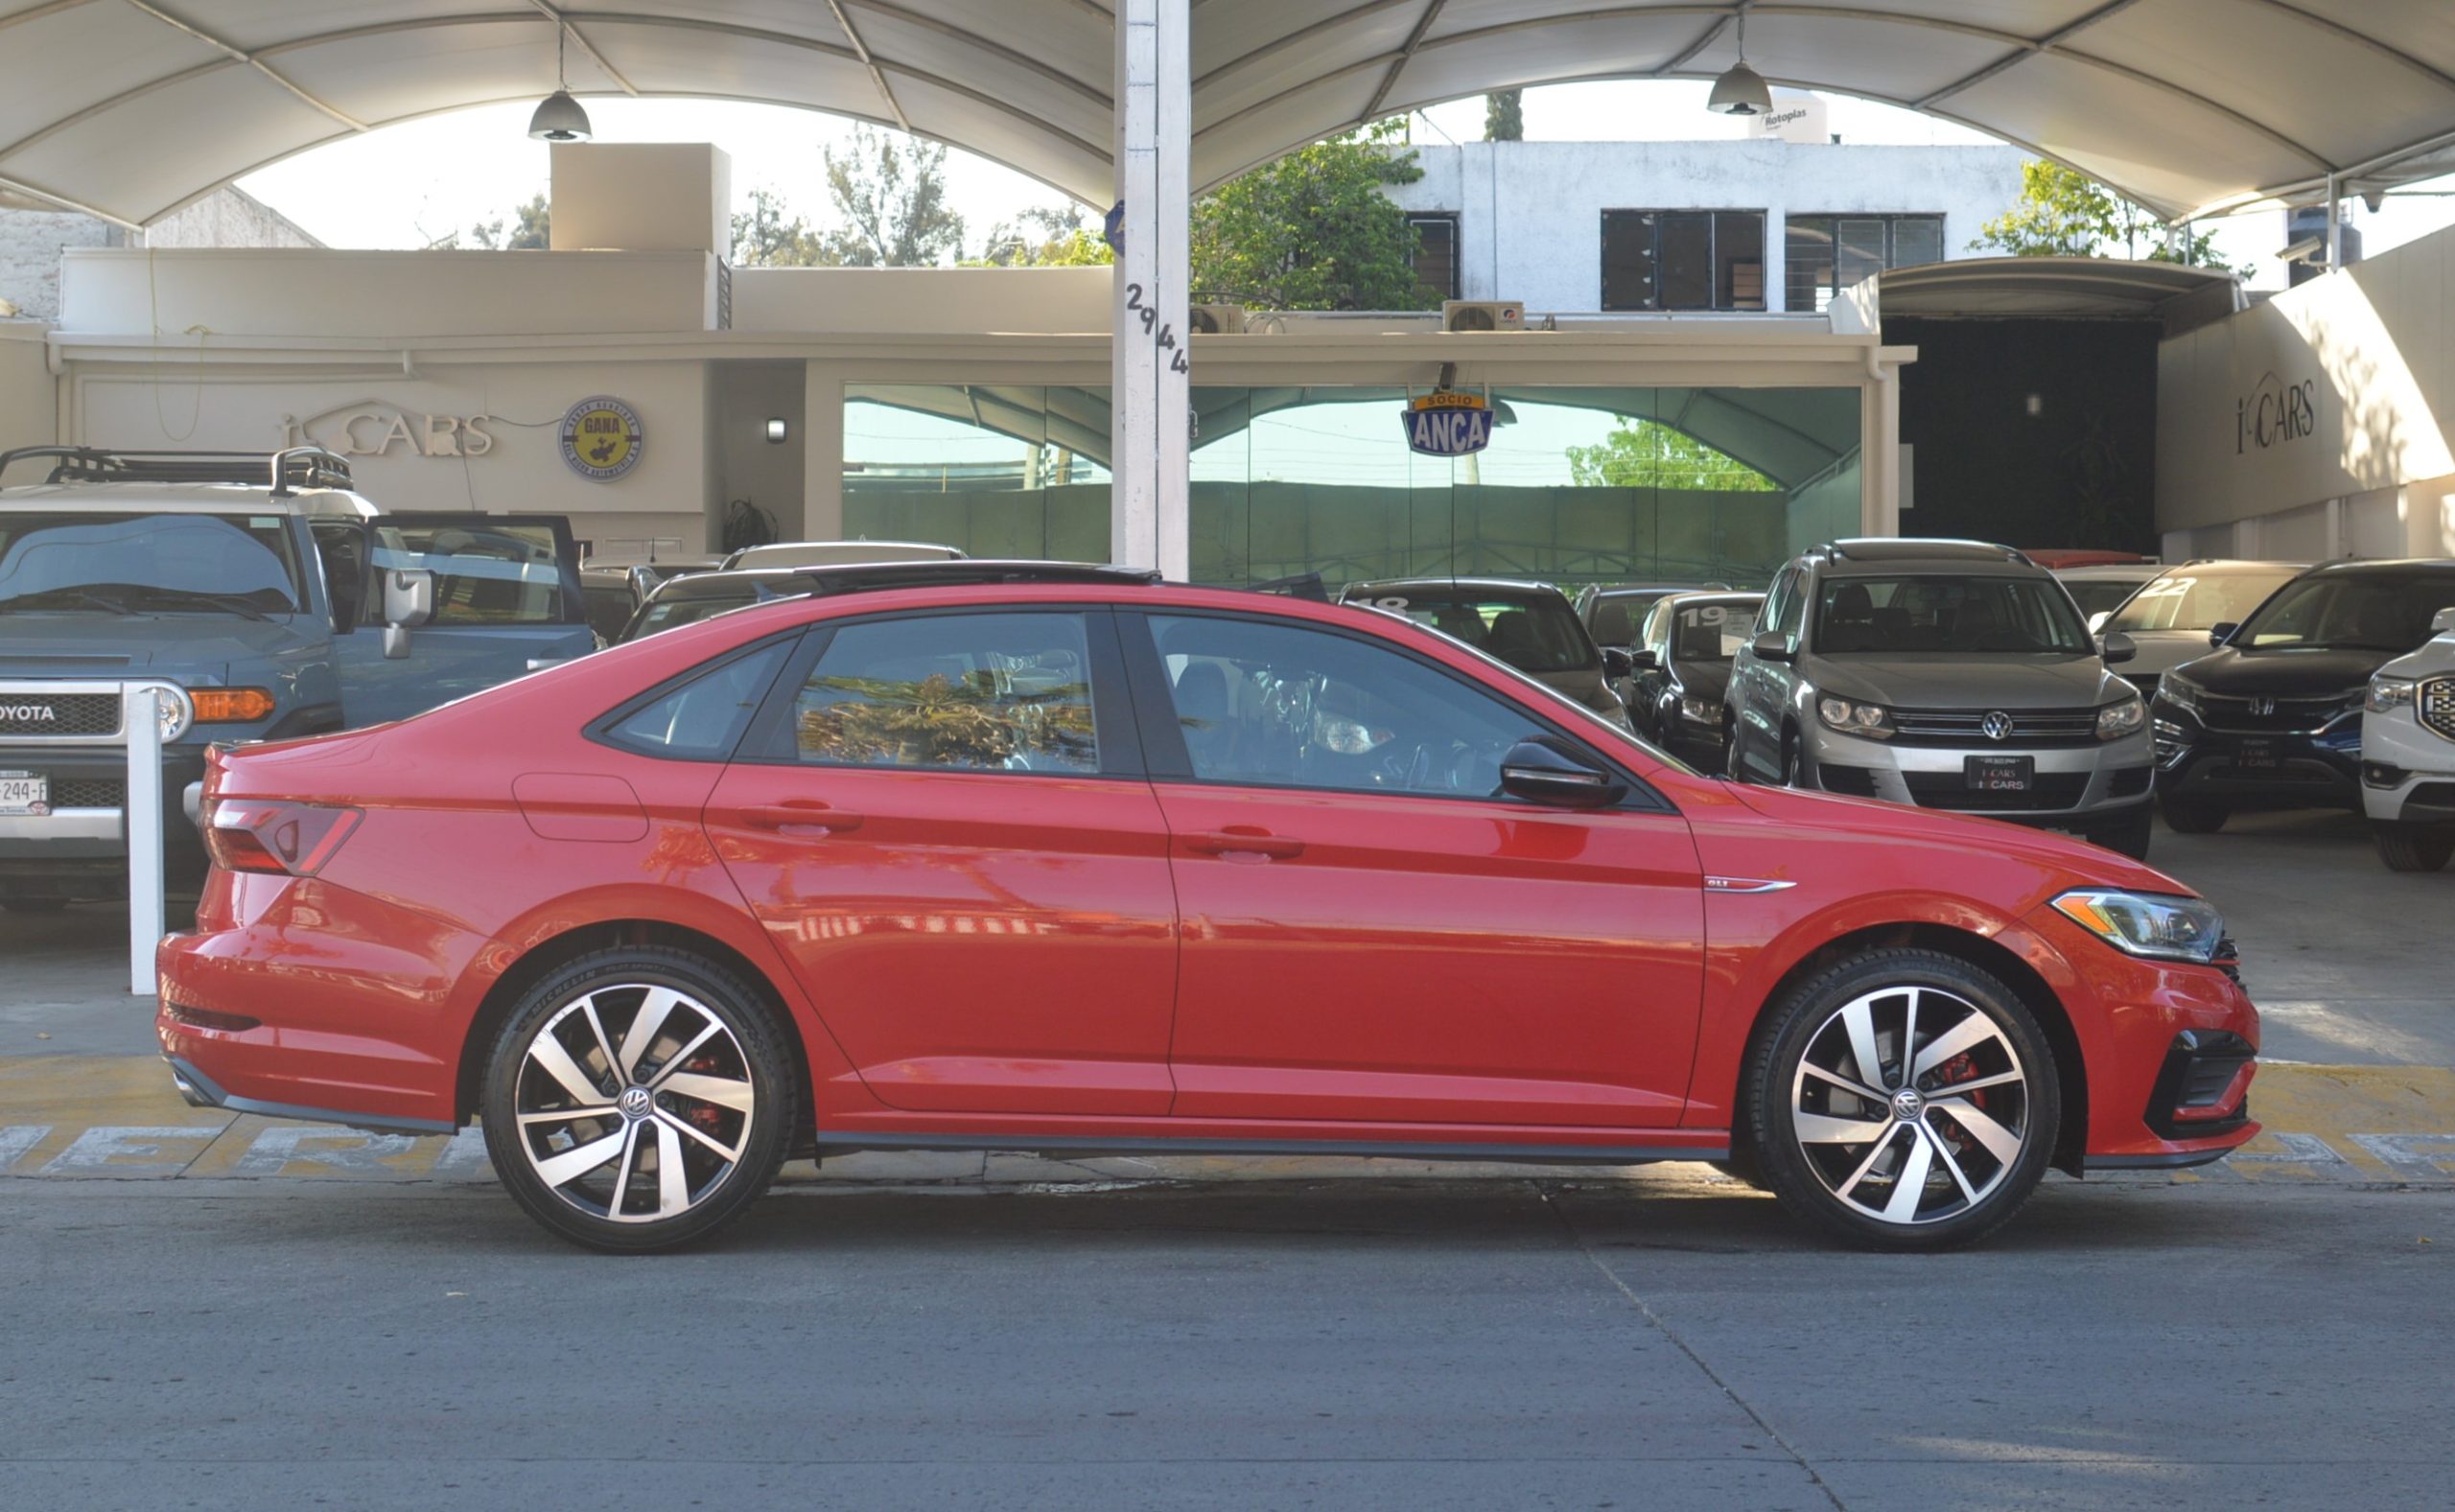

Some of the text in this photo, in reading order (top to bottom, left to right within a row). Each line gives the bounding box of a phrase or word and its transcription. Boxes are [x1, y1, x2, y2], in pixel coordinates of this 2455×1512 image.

[1765, 108, 1807, 127] Rotoplas
[1126, 283, 1189, 375] 2944
[1427, 395, 1473, 406] SOCIO
[2256, 378, 2315, 449] CARS
[344, 413, 494, 456] CARS
[584, 417, 620, 434] GANA
[1414, 411, 1486, 453] ANCA
[2138, 577, 2198, 599] 22
[1679, 606, 1728, 628] 19
[1991, 780, 2025, 790] CARS
[531, 969, 596, 1016] MICHELIN
